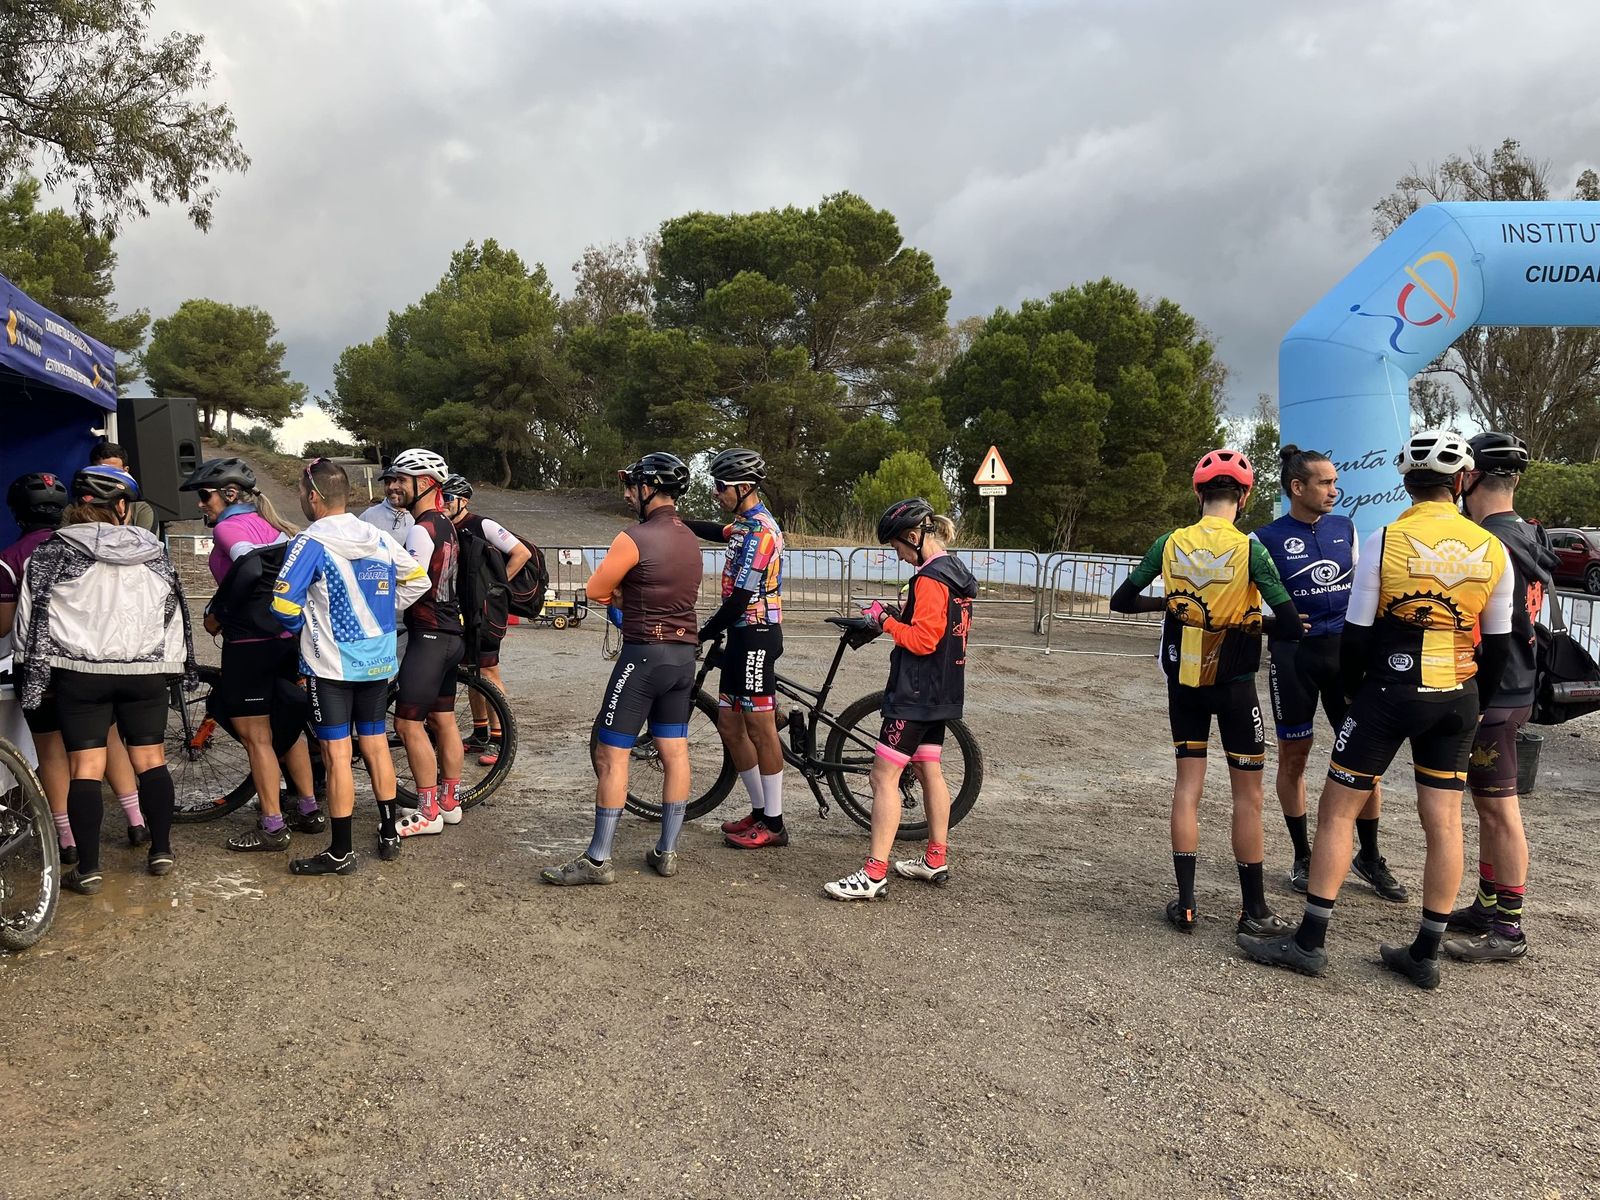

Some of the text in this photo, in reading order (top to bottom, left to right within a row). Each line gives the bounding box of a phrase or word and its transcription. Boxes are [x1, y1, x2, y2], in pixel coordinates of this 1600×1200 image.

[1501, 223, 1600, 243] INSTITU
[1525, 265, 1600, 283] CIUDA
[1323, 449, 1387, 472] uta
[737, 539, 758, 582] BALEARIA
[1411, 560, 1490, 577] TITANES
[1293, 589, 1309, 597] C.D.
[1310, 586, 1327, 595] SAN
[745, 651, 756, 691] SEPTEM
[755, 649, 766, 693] FRATRES
[311, 692, 319, 707] SAN
[604, 663, 635, 726] C.D. SAN URBANO
[314, 708, 322, 722] C.D.
[1252, 706, 1262, 728] on
[1273, 692, 1283, 720] URBANO
[1335, 716, 1353, 752] on 365
